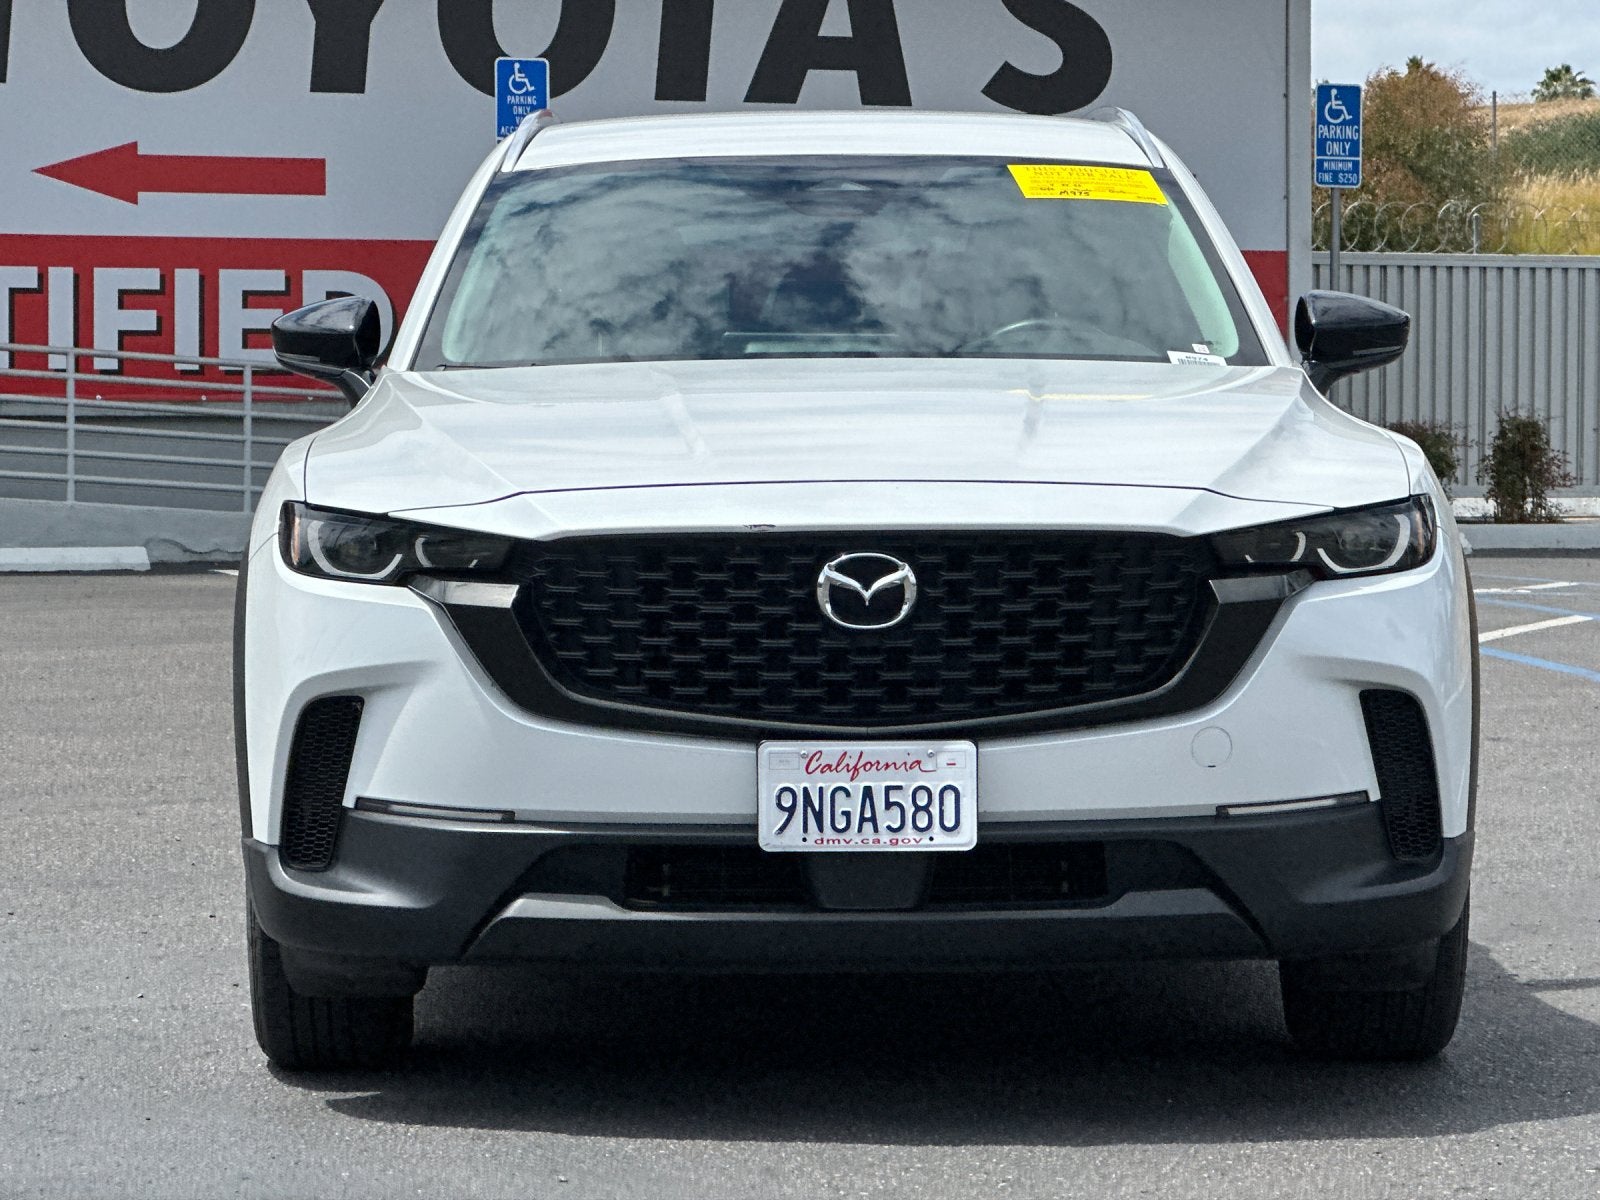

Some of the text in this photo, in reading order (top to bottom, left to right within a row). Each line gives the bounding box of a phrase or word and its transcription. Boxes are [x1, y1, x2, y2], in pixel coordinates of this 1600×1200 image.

[507, 95, 537, 105] PARKING
[513, 106, 531, 115] ONLY
[1318, 125, 1358, 140] PARKING
[1326, 142, 1350, 155] ONLY
[1323, 161, 1353, 171] MINIMUM
[1318, 172, 1357, 184] FINE $250
[804, 750, 937, 782] California
[775, 784, 961, 835] 9NGA580
[814, 835, 924, 845] dmv.ca.gov
